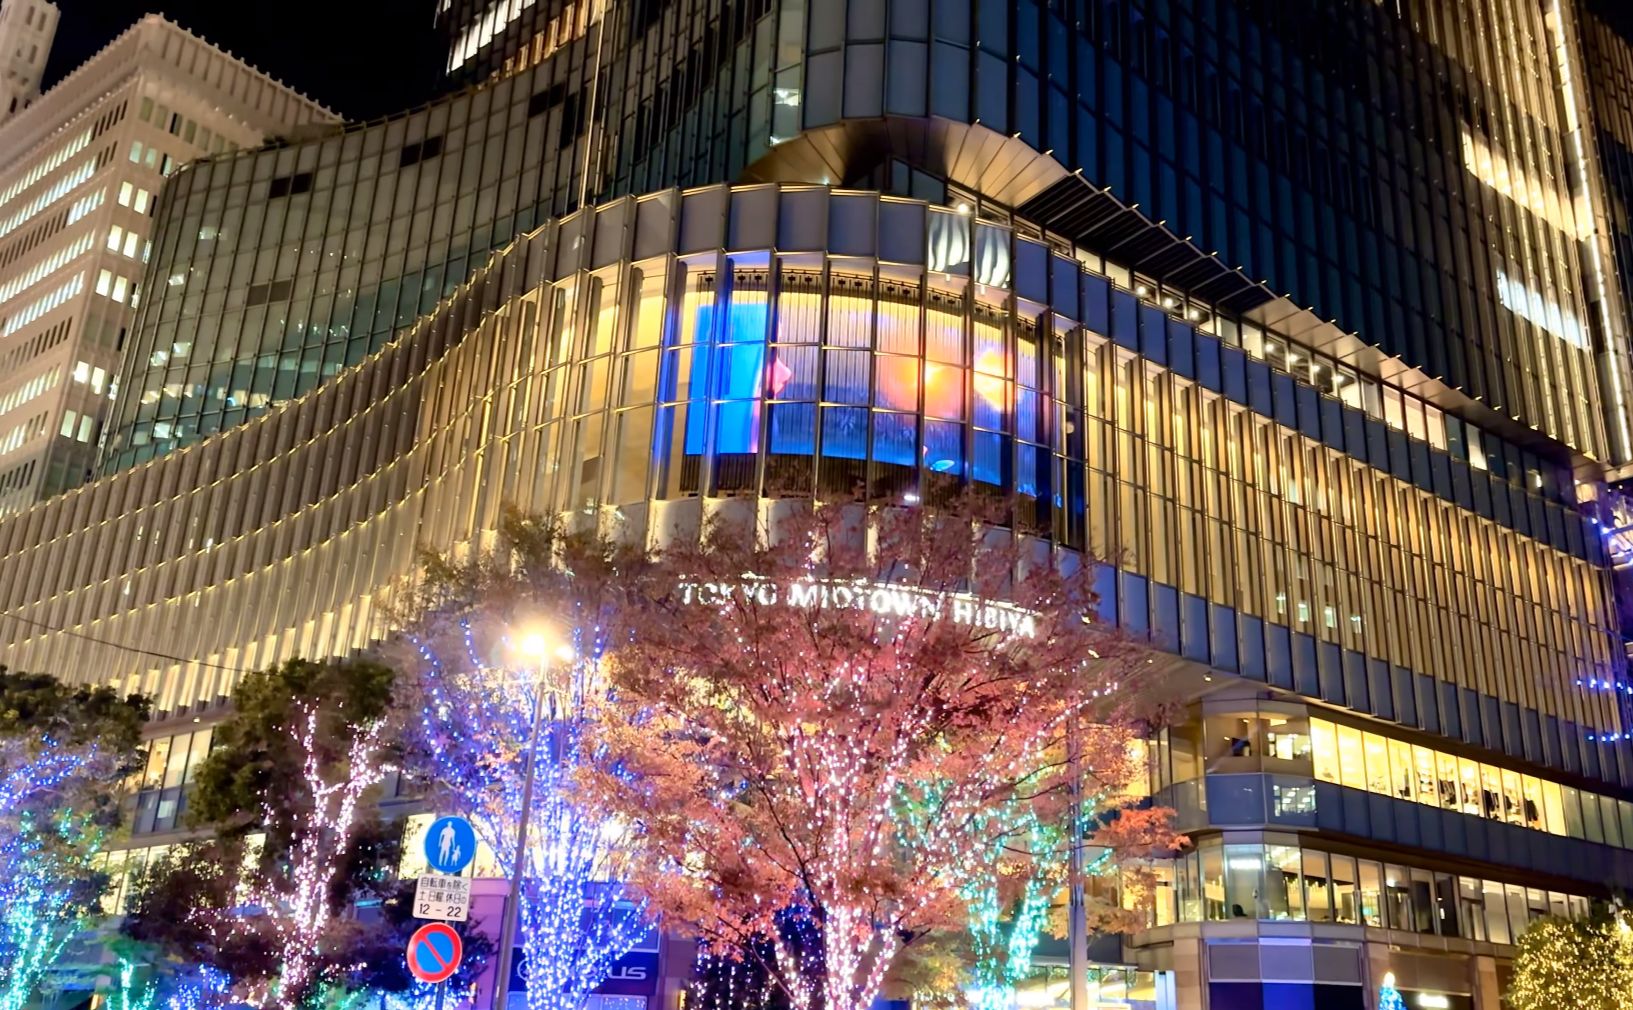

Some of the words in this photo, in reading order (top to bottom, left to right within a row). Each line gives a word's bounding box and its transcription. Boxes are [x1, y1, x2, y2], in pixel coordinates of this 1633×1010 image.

[678, 582, 777, 605] TOKYO
[787, 583, 945, 622] MIDTOWN
[953, 599, 1036, 639] HIBIYA
[421, 877, 468, 891] 自転車を除く
